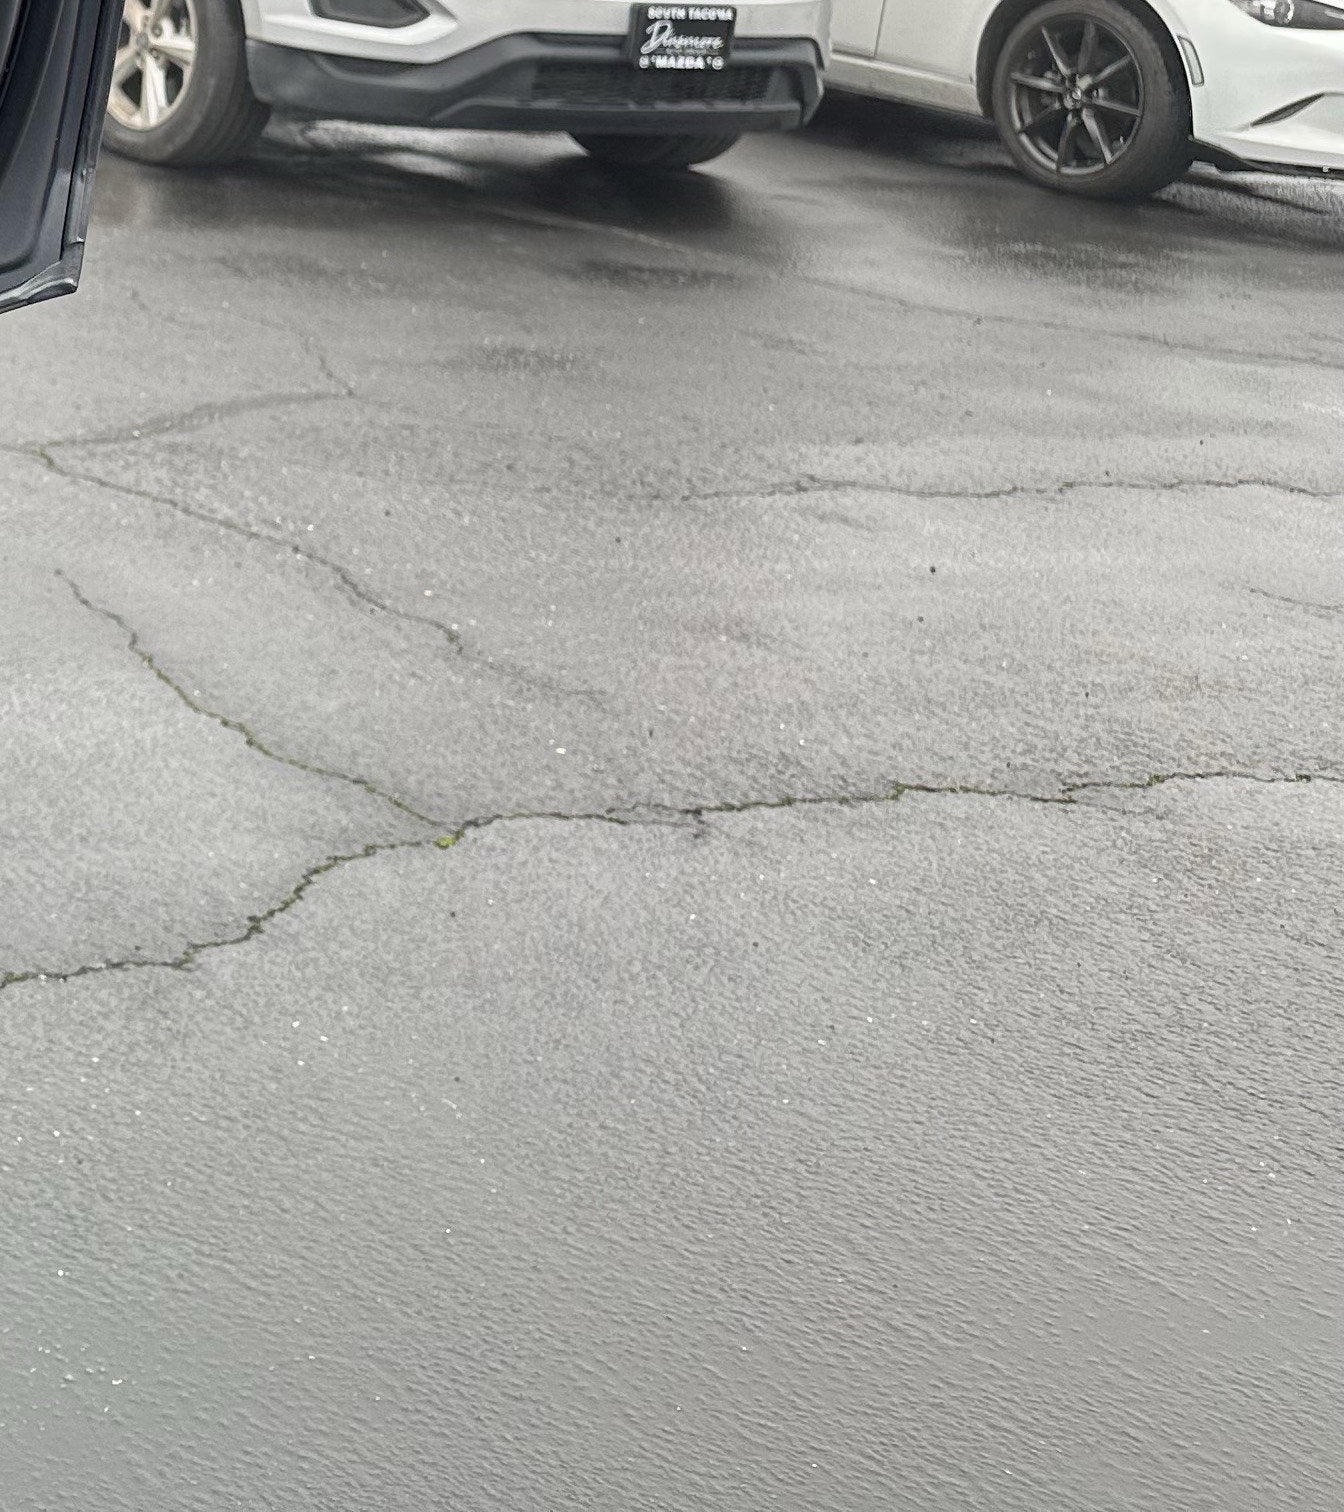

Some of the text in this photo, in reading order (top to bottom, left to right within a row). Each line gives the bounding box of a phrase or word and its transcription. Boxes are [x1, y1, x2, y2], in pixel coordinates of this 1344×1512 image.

[647, 5, 733, 21] SOUTH TACOMA
[656, 54, 705, 70] MAZDA
